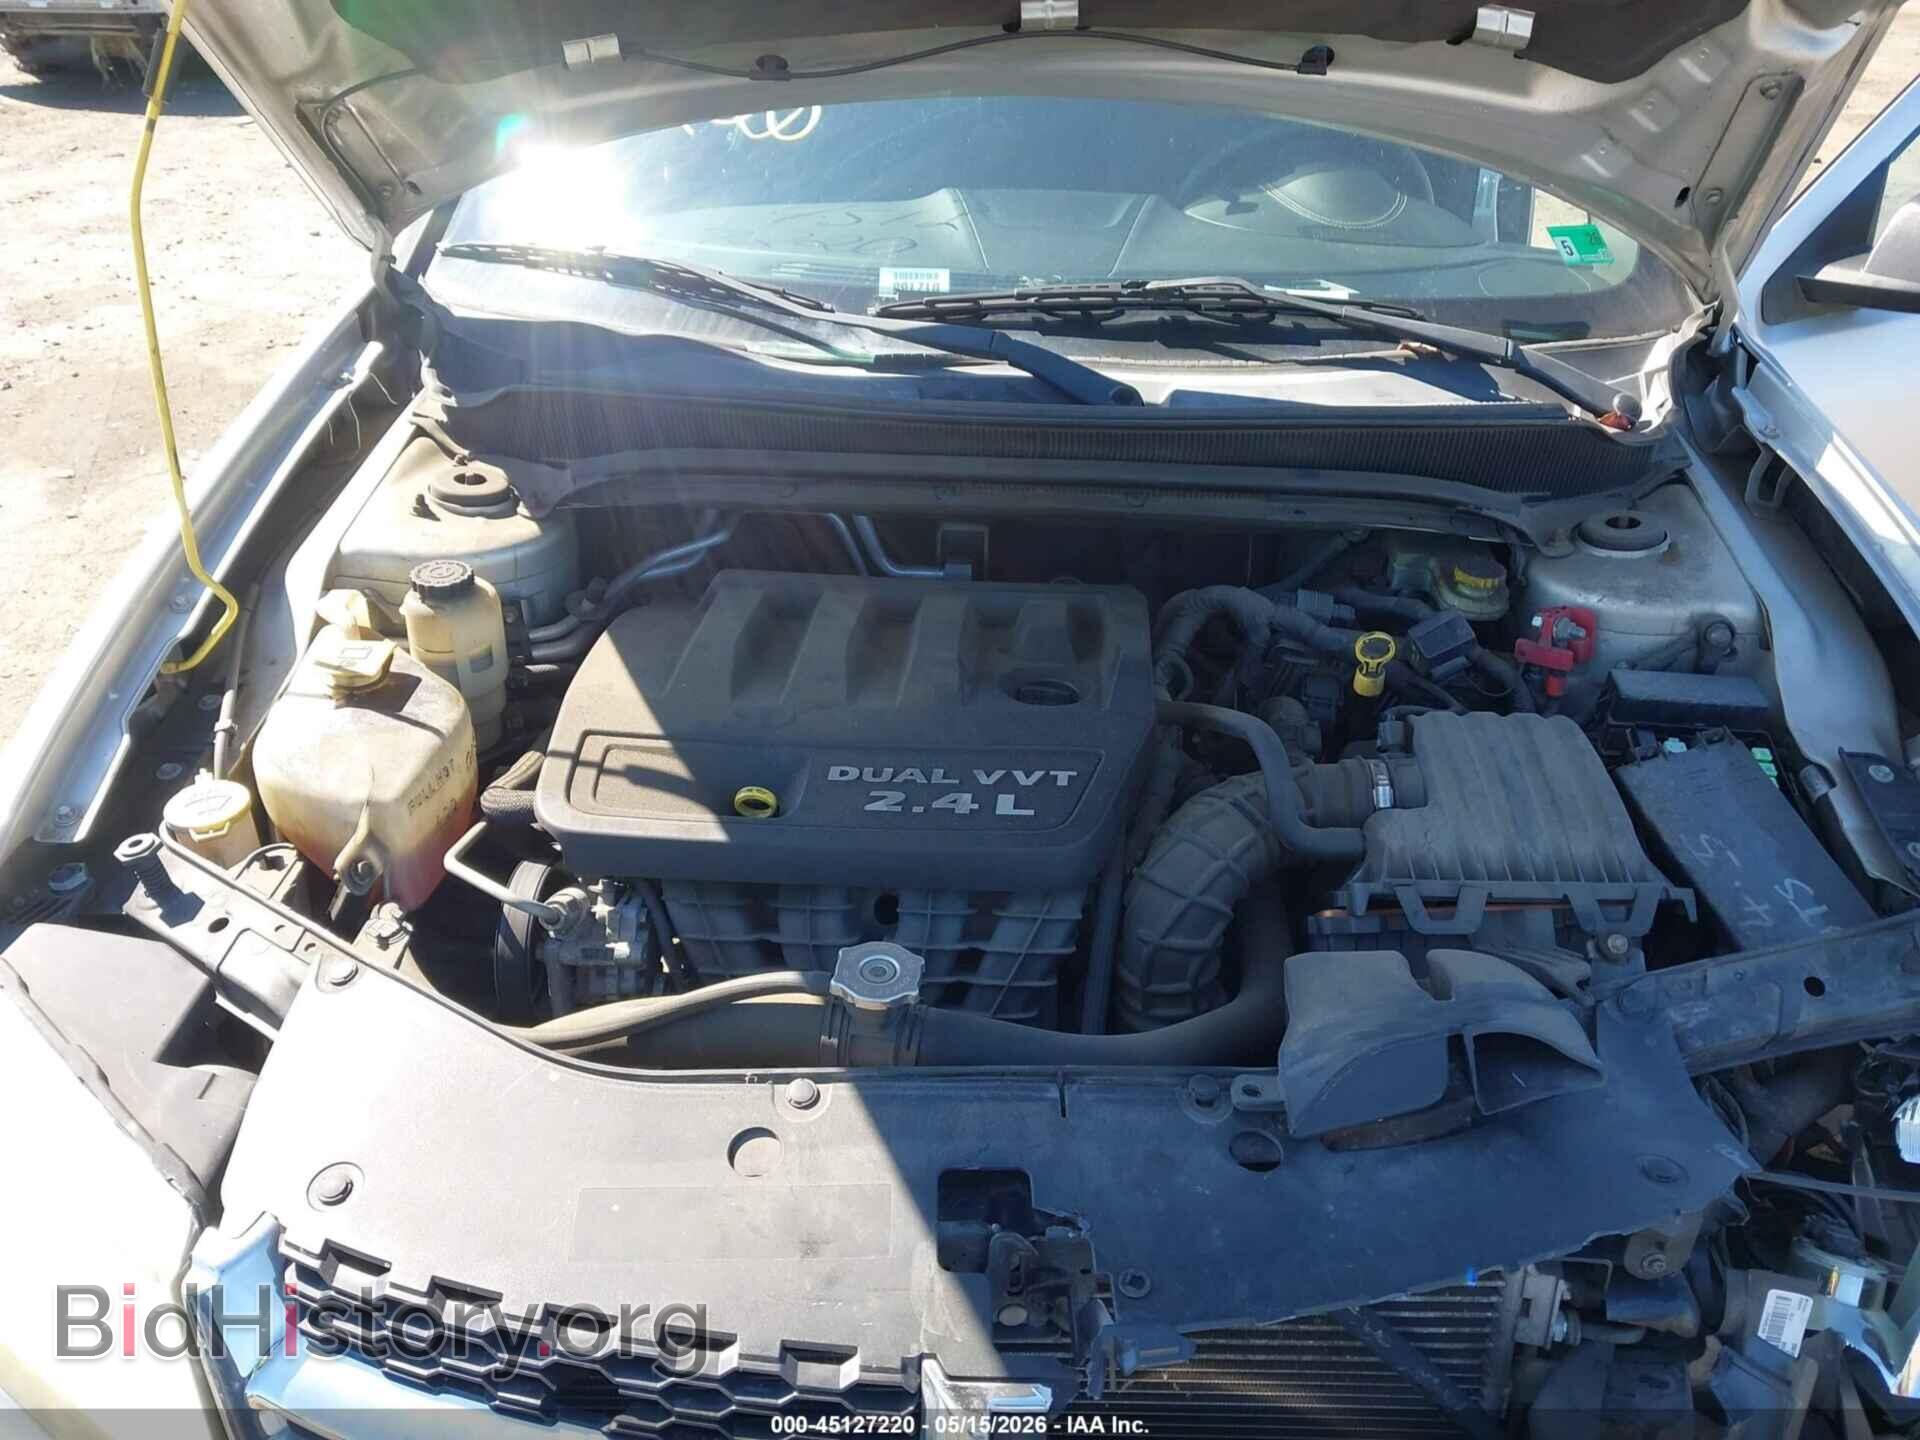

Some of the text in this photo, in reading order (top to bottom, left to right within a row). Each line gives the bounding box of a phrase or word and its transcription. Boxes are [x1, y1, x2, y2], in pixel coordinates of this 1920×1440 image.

[1560, 239, 1574, 257] 5
[827, 766, 1078, 786] DUAL VVT
